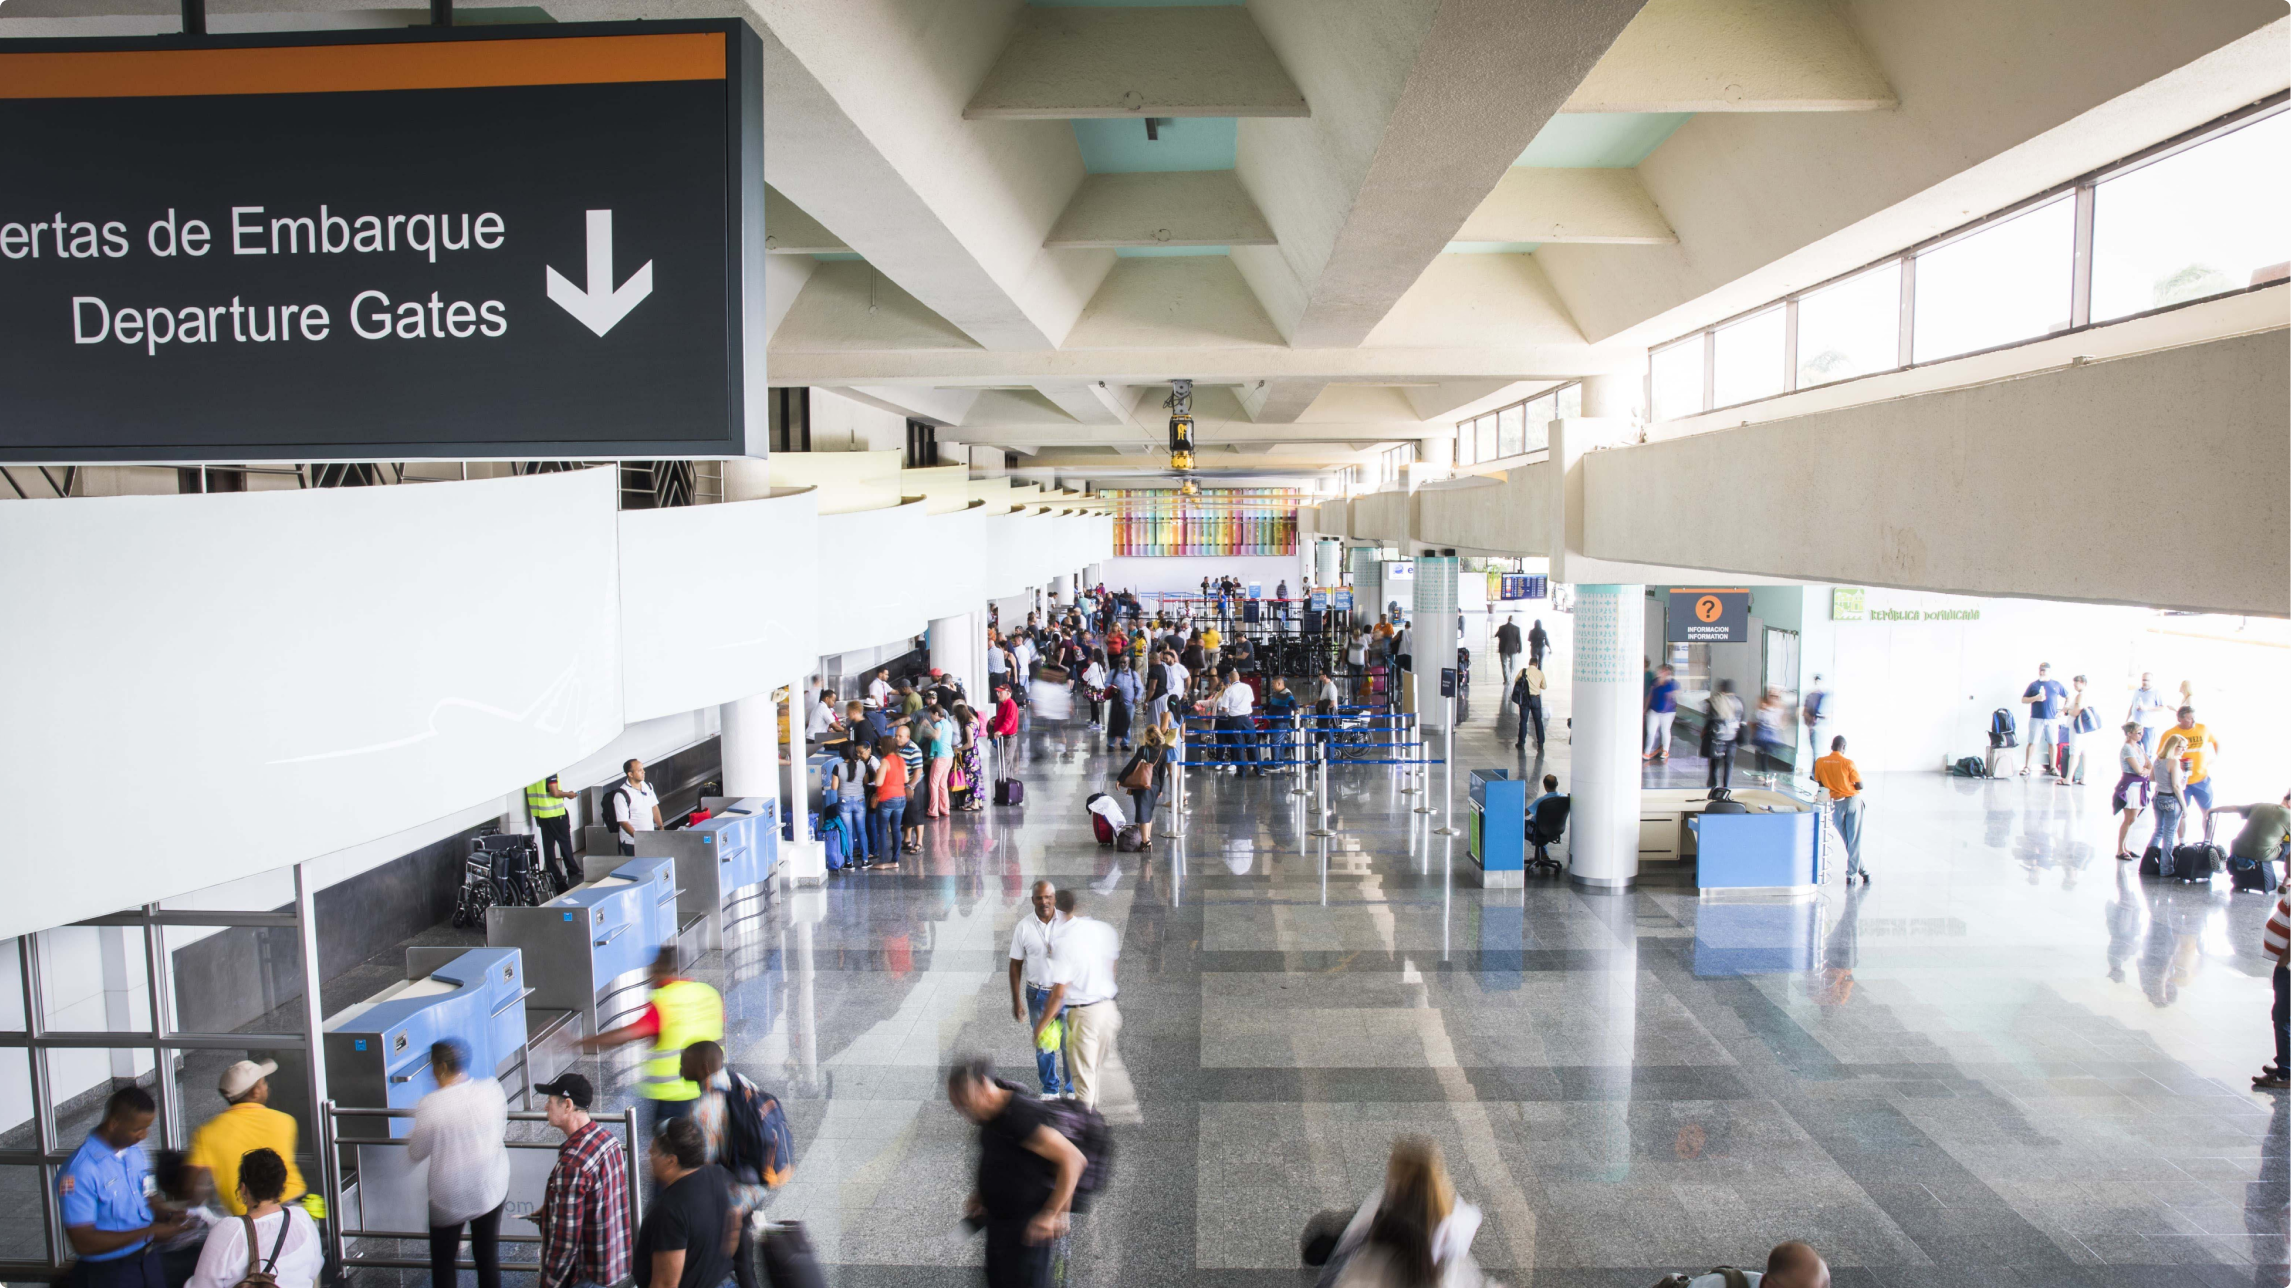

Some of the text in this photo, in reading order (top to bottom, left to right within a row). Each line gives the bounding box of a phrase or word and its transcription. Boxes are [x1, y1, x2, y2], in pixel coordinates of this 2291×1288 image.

[0, 205, 505, 264] ertas de Embarque
[73, 290, 508, 356] Departure Gates
